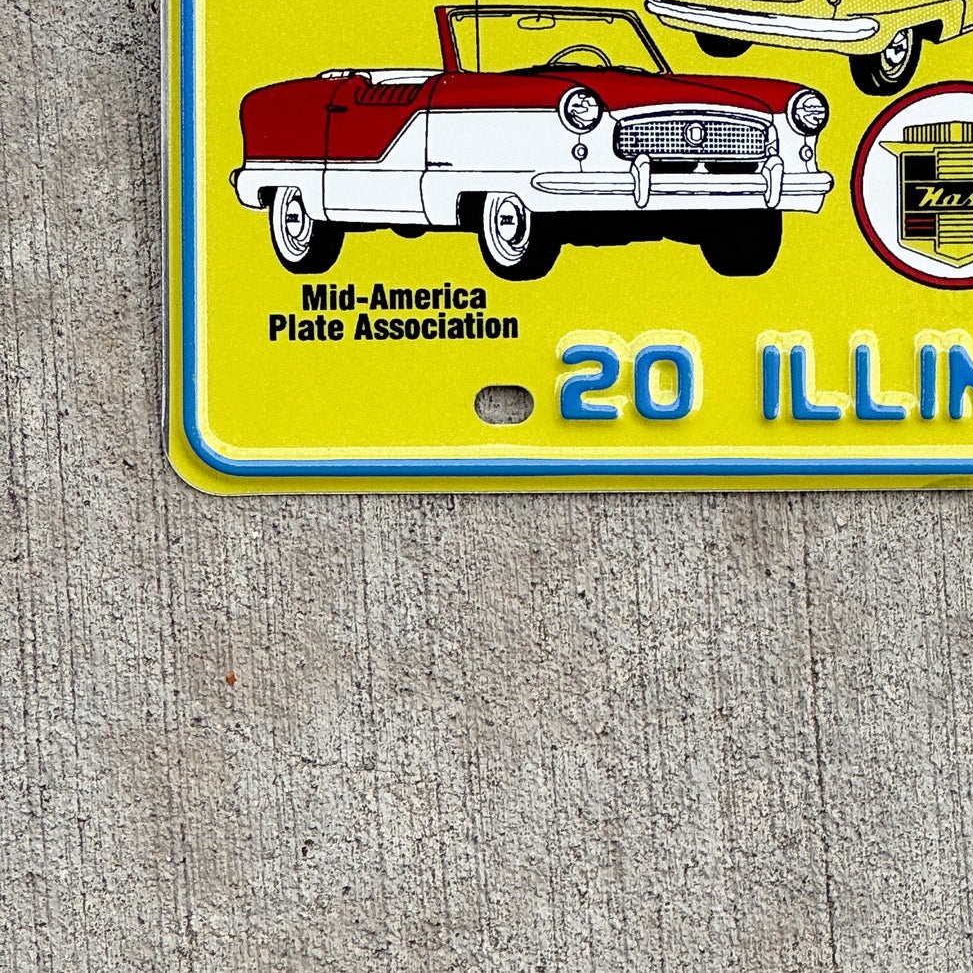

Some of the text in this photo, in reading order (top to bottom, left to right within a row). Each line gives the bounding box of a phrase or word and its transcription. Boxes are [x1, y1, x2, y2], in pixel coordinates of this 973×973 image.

[301, 283, 488, 311] Mid-America
[269, 311, 519, 342] Plate Association
[560, 344, 695, 420] 20
